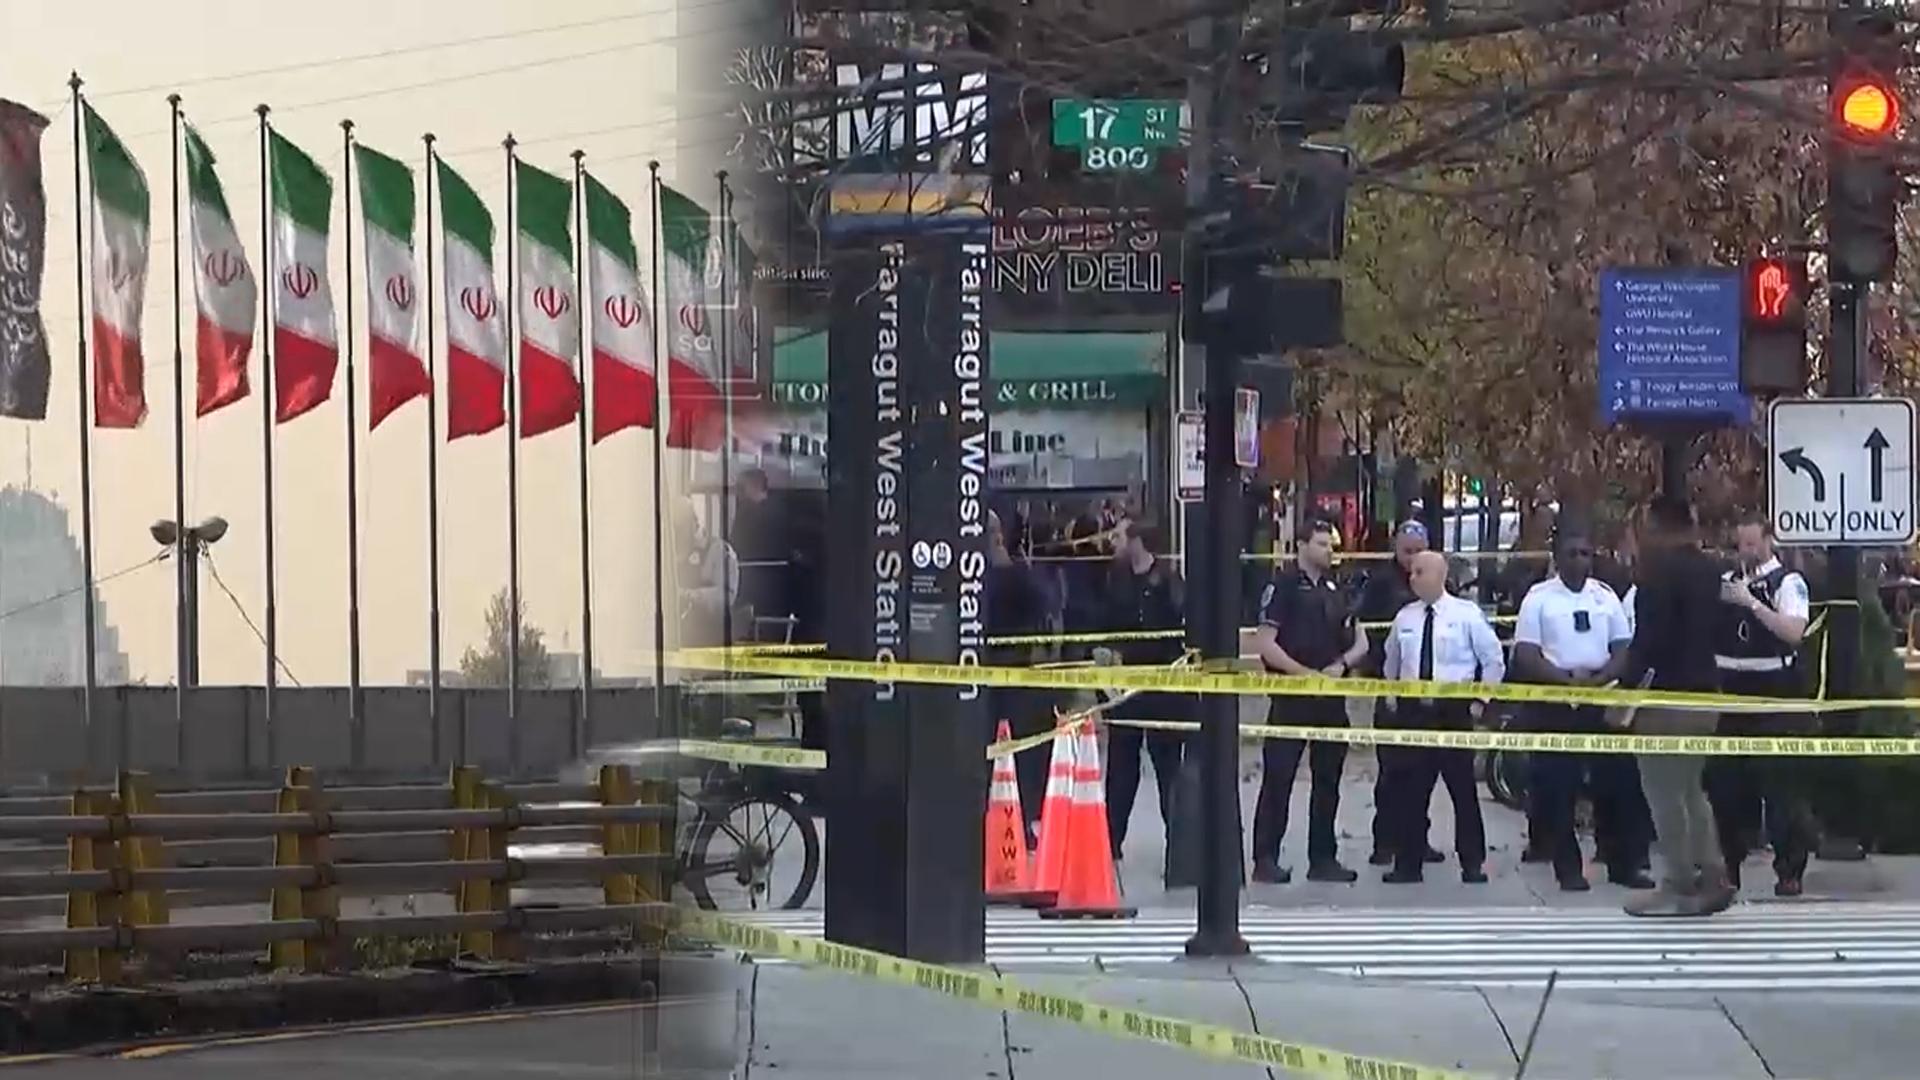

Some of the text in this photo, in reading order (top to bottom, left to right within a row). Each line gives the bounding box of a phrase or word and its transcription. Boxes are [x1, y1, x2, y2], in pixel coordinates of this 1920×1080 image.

[1078, 106, 1168, 140] 17 ST
[1087, 146, 1149, 170] 800
[991, 252, 1162, 294] NY DELI
[954, 243, 987, 424] Farragut
[997, 380, 1117, 402] & GRILL
[876, 431, 903, 537] West
[959, 432, 986, 537] West
[1779, 510, 1837, 532] ONLY
[1847, 510, 1904, 532] ONLY
